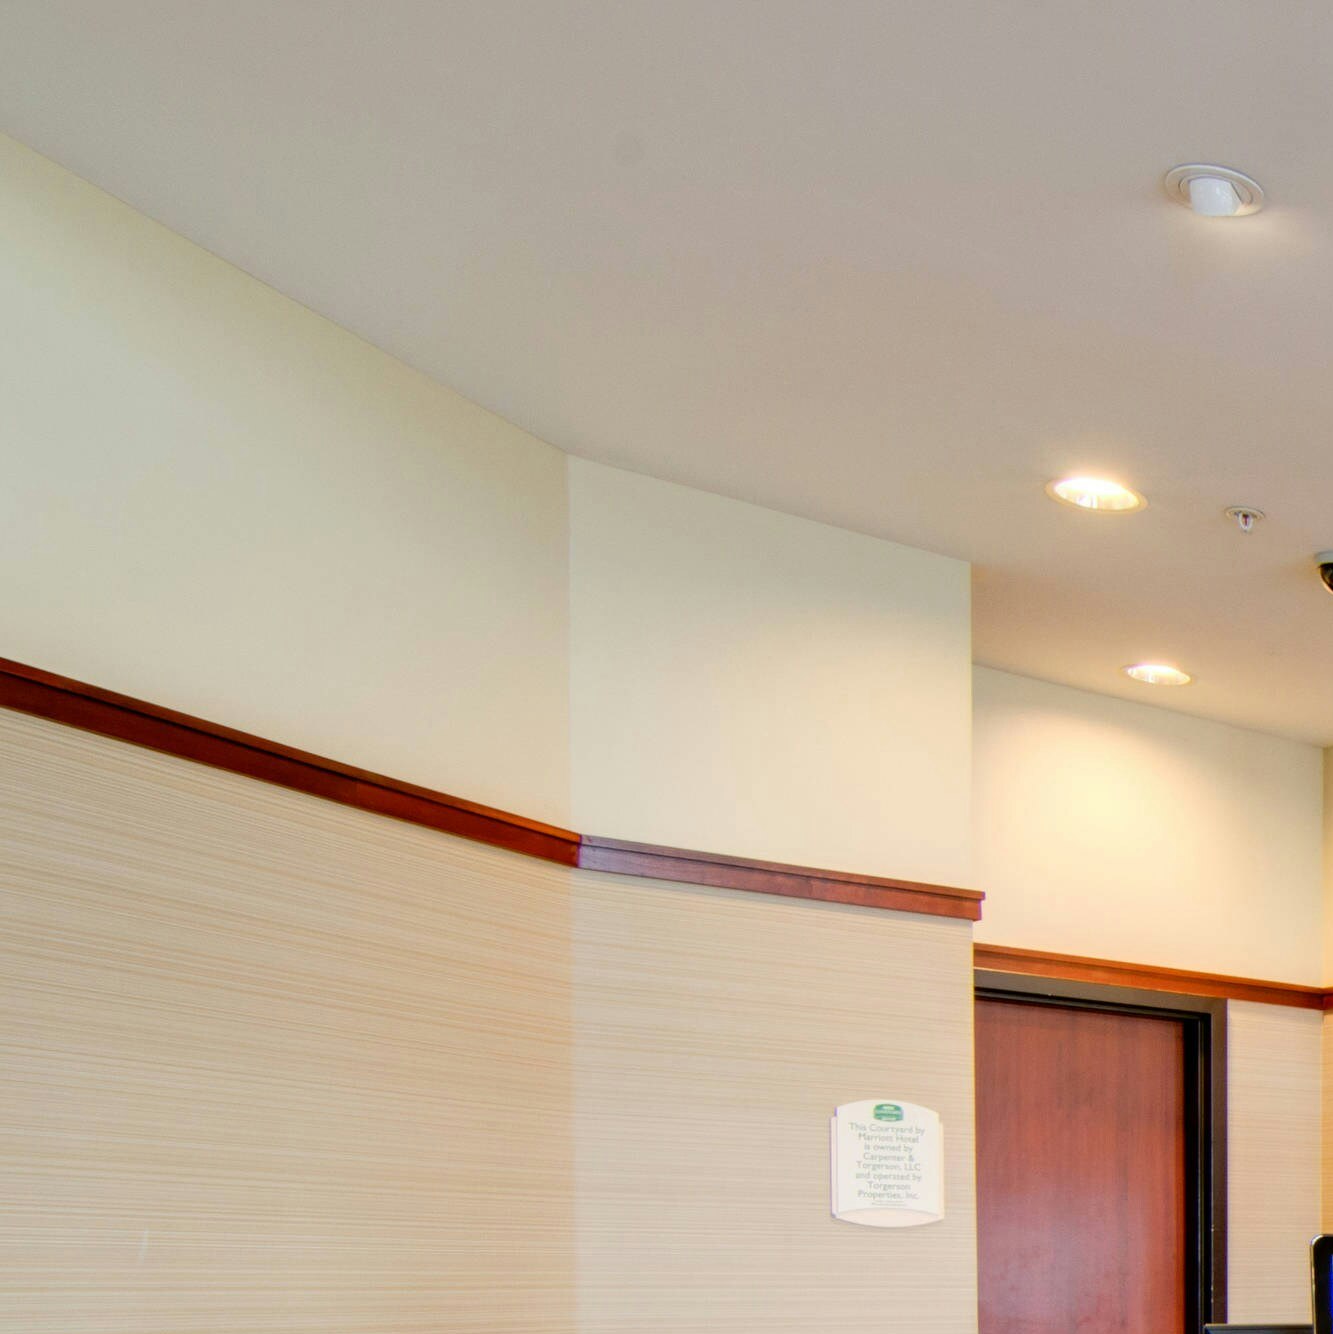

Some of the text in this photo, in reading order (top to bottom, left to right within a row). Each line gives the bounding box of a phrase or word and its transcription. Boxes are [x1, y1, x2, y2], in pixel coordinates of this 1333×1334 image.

[848, 1122, 926, 1136] This Courtyard by
[858, 1132, 919, 1143] Marriott Hotel
[863, 1143, 913, 1153] is owned by
[863, 1152, 915, 1162] Carpenter &
[904, 1163, 921, 1171] LLC
[856, 1172, 922, 1182] and operated by
[867, 1181, 912, 1192] Torgerson
